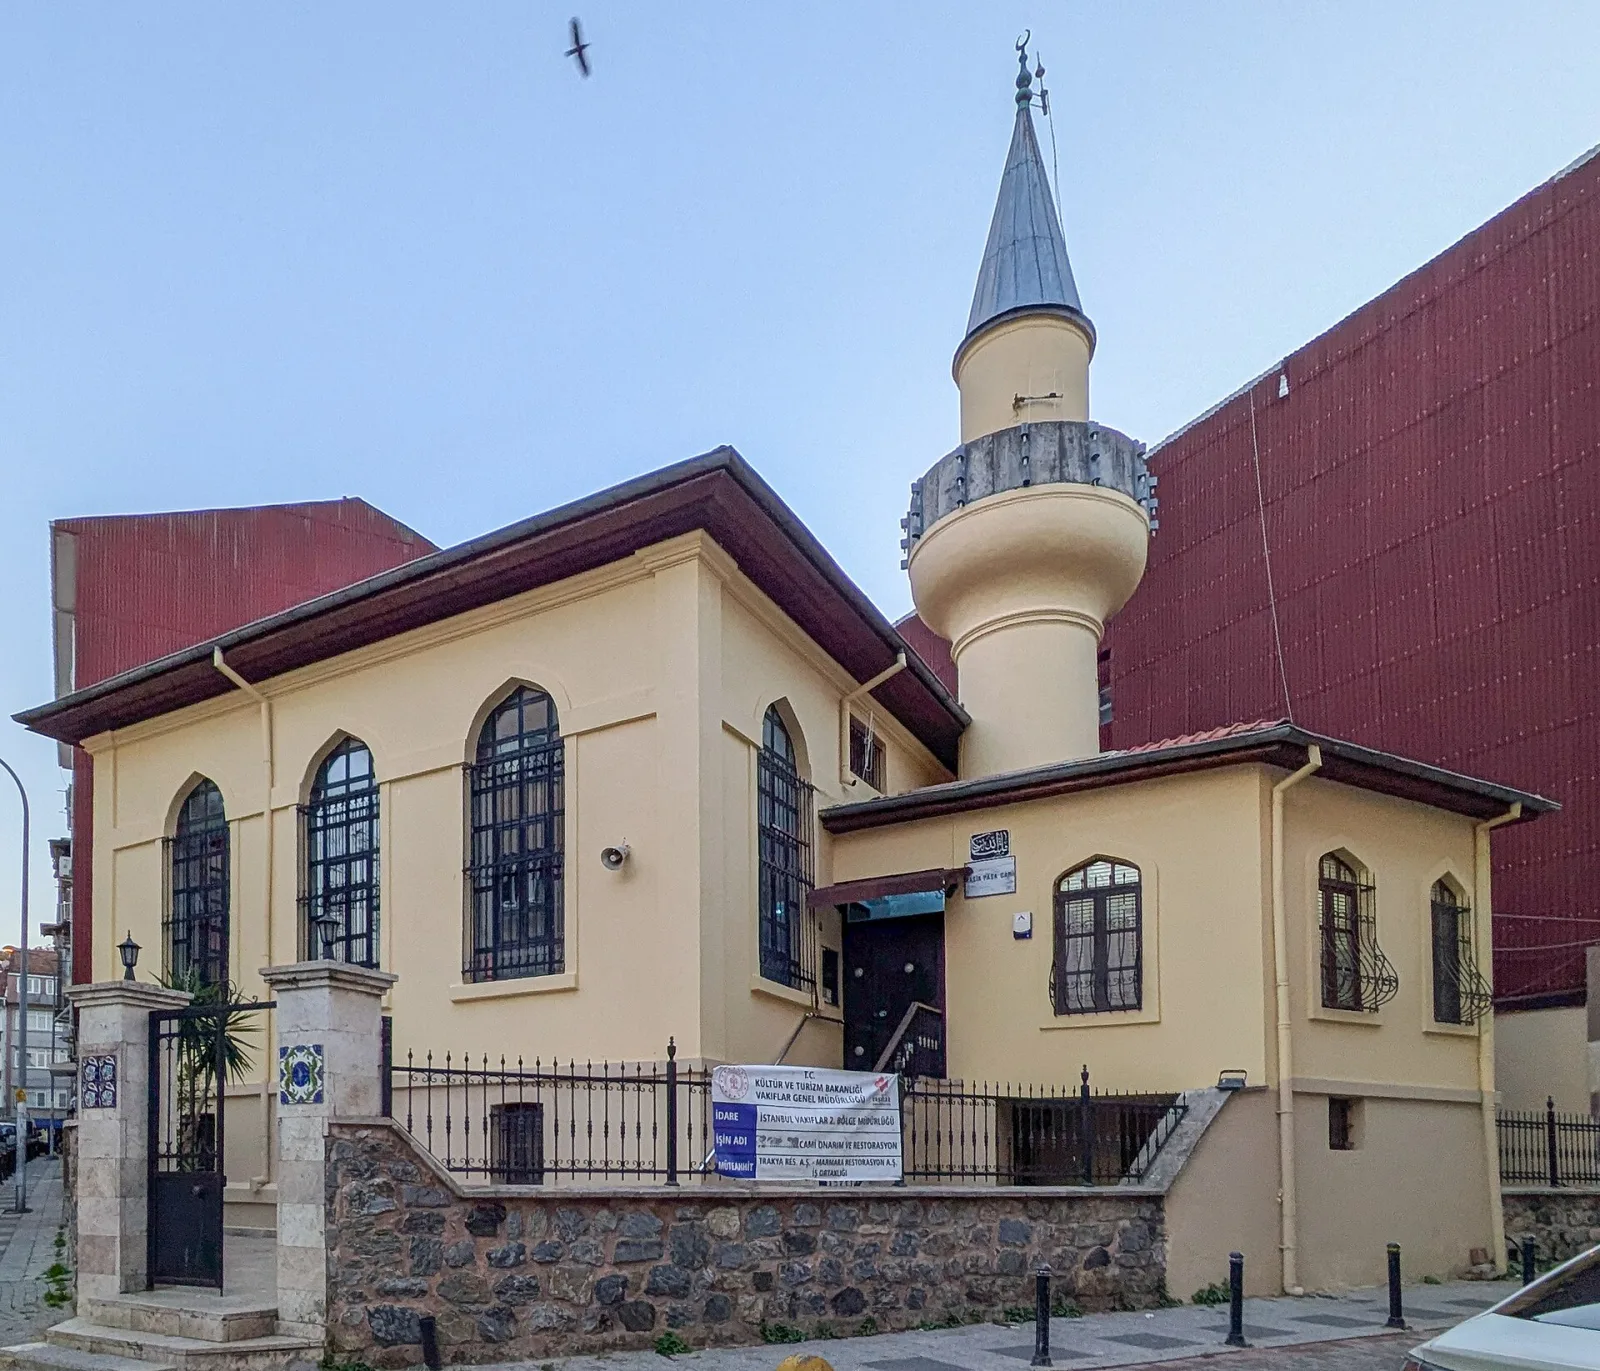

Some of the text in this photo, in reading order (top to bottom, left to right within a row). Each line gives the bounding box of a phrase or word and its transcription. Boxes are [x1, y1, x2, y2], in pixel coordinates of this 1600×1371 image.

[804, 1070, 816, 1080] T.C.
[755, 1077, 863, 1094] KÜLTÜR VE TURİZM BAKANLIĞI
[756, 1091, 791, 1102] VAKIFLAR
[793, 1094, 816, 1103] GENEL
[818, 1094, 866, 1104] MÜDÜRLÜĞÜ
[715, 1109, 738, 1121] İDARE
[760, 1111, 895, 1126] İSTANBUL VAKIFLAR 2. BÖLGE MÜDÜRLÜĞÜ
[716, 1133, 732, 1146] İŞİN
[734, 1136, 747, 1146] ADI
[800, 1139, 816, 1148] CAMİ
[818, 1140, 844, 1150] ONARIM
[844, 1141, 852, 1149] VE
[852, 1141, 898, 1150] RESTORASYON
[718, 1160, 754, 1172] MÜTEAHHİT
